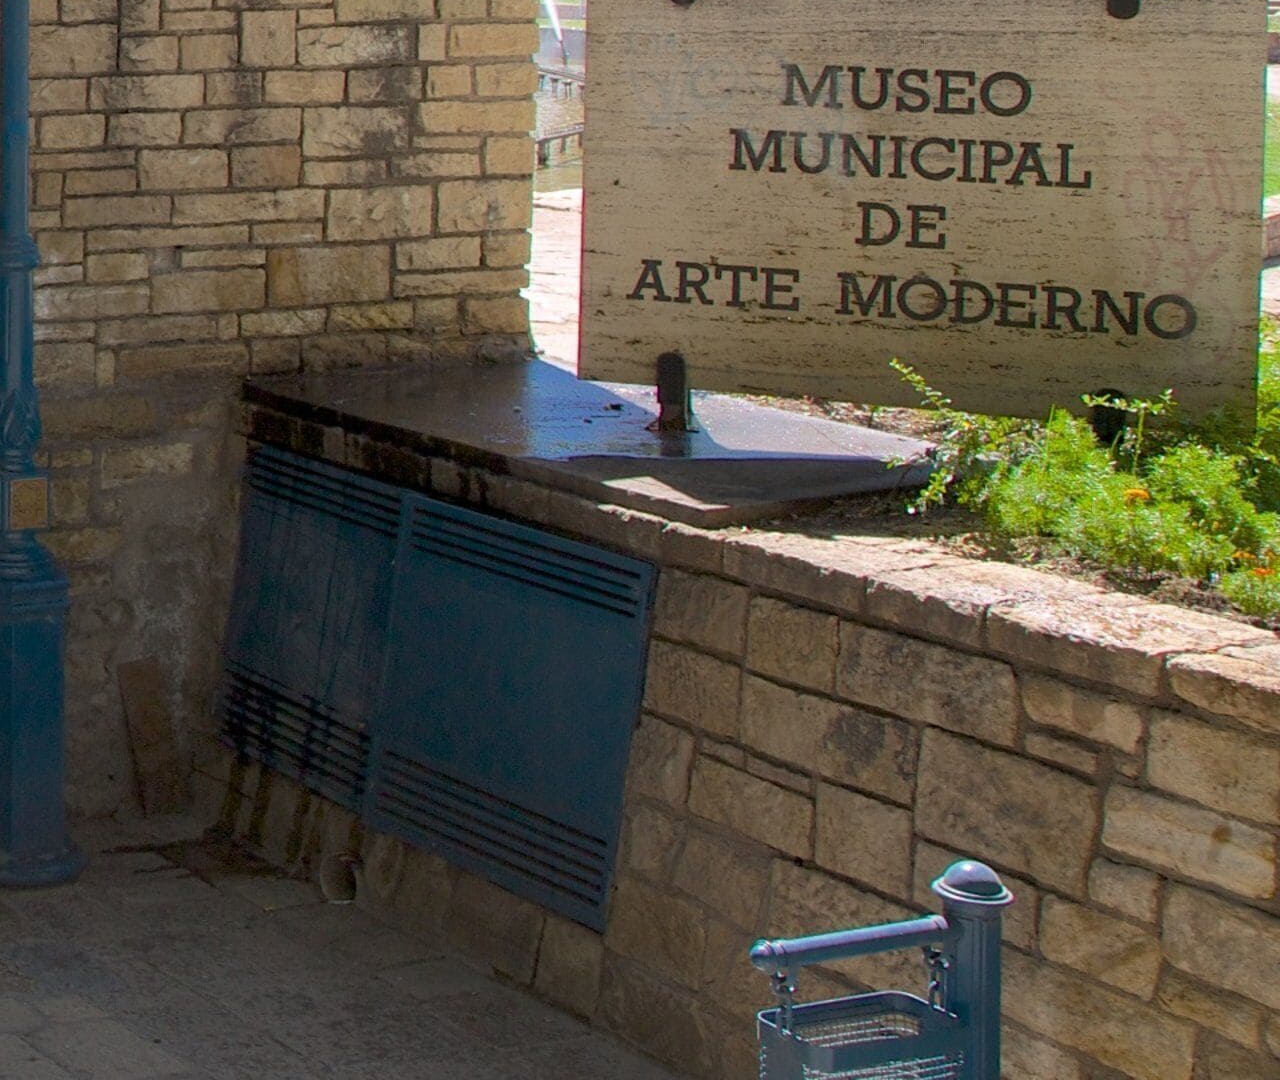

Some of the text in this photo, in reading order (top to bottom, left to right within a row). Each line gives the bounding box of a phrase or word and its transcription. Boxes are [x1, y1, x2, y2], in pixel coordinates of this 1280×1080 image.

[780, 63, 1032, 118] MUSEO
[728, 127, 1093, 190] MUNICIPAL
[854, 201, 947, 250] DE
[626, 259, 1198, 341] ARTE MODERNO
